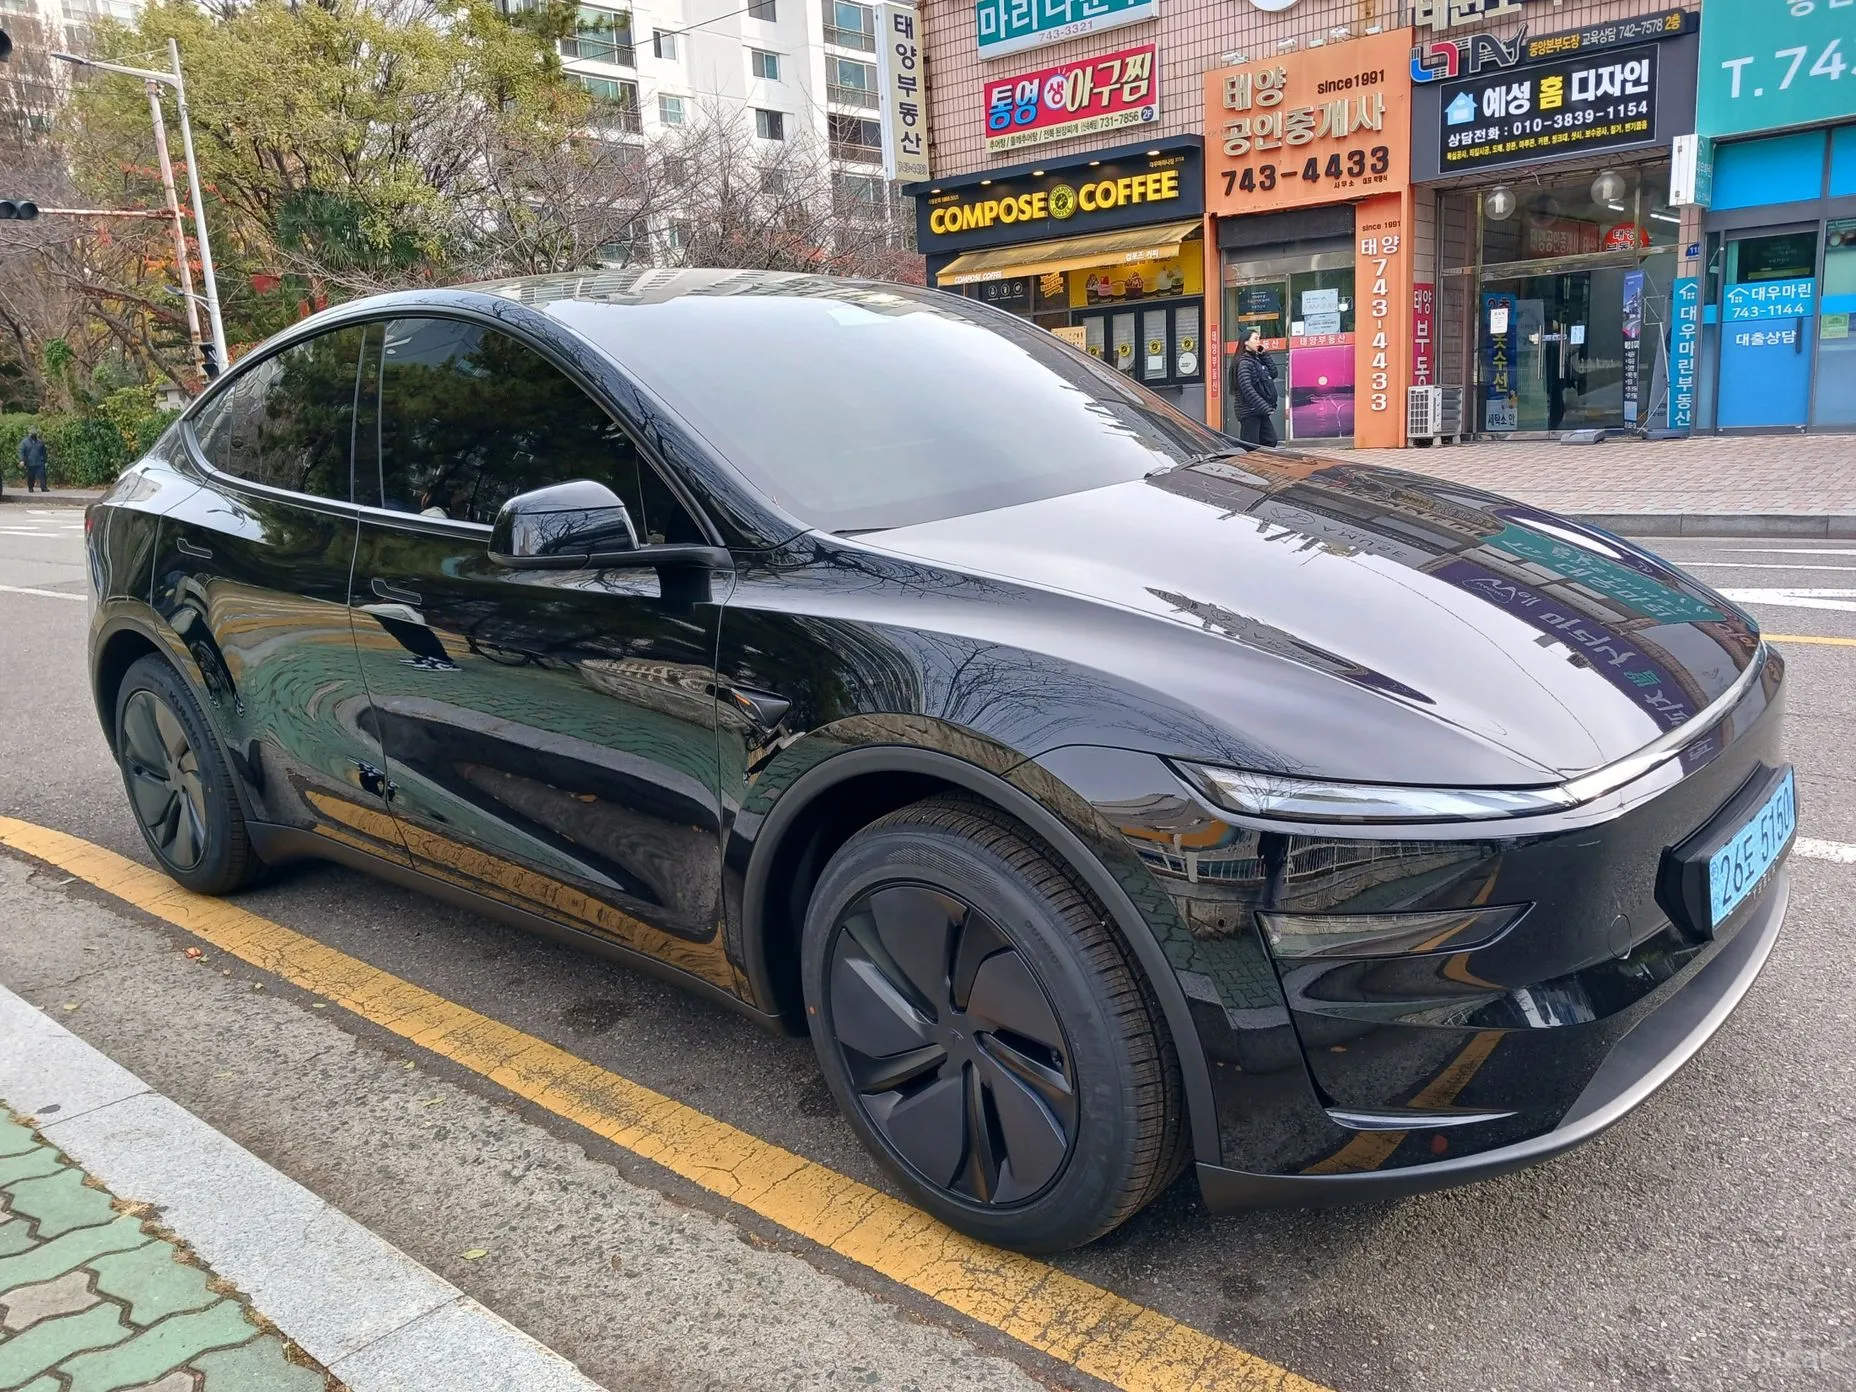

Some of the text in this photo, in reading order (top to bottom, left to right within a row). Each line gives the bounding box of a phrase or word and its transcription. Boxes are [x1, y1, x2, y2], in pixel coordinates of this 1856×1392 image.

[1039, 21, 1094, 42] 743-3321
[1529, 13, 1681, 57] 중앙본부도장 교육상담 742-7578 2층
[1775, 38, 1856, 91] 74
[893, 13, 922, 156] 태양부동산
[1222, 66, 1287, 111] 태양
[1482, 59, 1650, 118] 예성 홈 디자인
[989, 79, 1040, 130] 통영
[1100, 110, 1139, 128] 731-7856
[1143, 108, 1152, 119] 2F
[1512, 101, 1648, 135] 010-3839-1154
[1221, 92, 1386, 157] 공인중개사
[1221, 145, 1389, 197] 743-4433
[930, 170, 1179, 234] COMPOSE COFFEE
[1362, 220, 1401, 232] since 1991
[1126, 249, 1159, 262] 컴포즈 커피
[1361, 235, 1400, 256] 태양
[954, 270, 1003, 284] COMPOSE COFFEE
[1752, 283, 1811, 301] 대우마린
[1414, 289, 1432, 315] 태양
[1733, 303, 1804, 318] 743-1144
[1299, 334, 1347, 347] 태양부동산
[1371, 258, 1388, 411] 743-4433
[1735, 330, 1797, 347] 대출상담
[1674, 305, 1697, 427] 대우마린부동산
[1488, 414, 1507, 427] 세탁소
[1761, 787, 1789, 862] 5150
